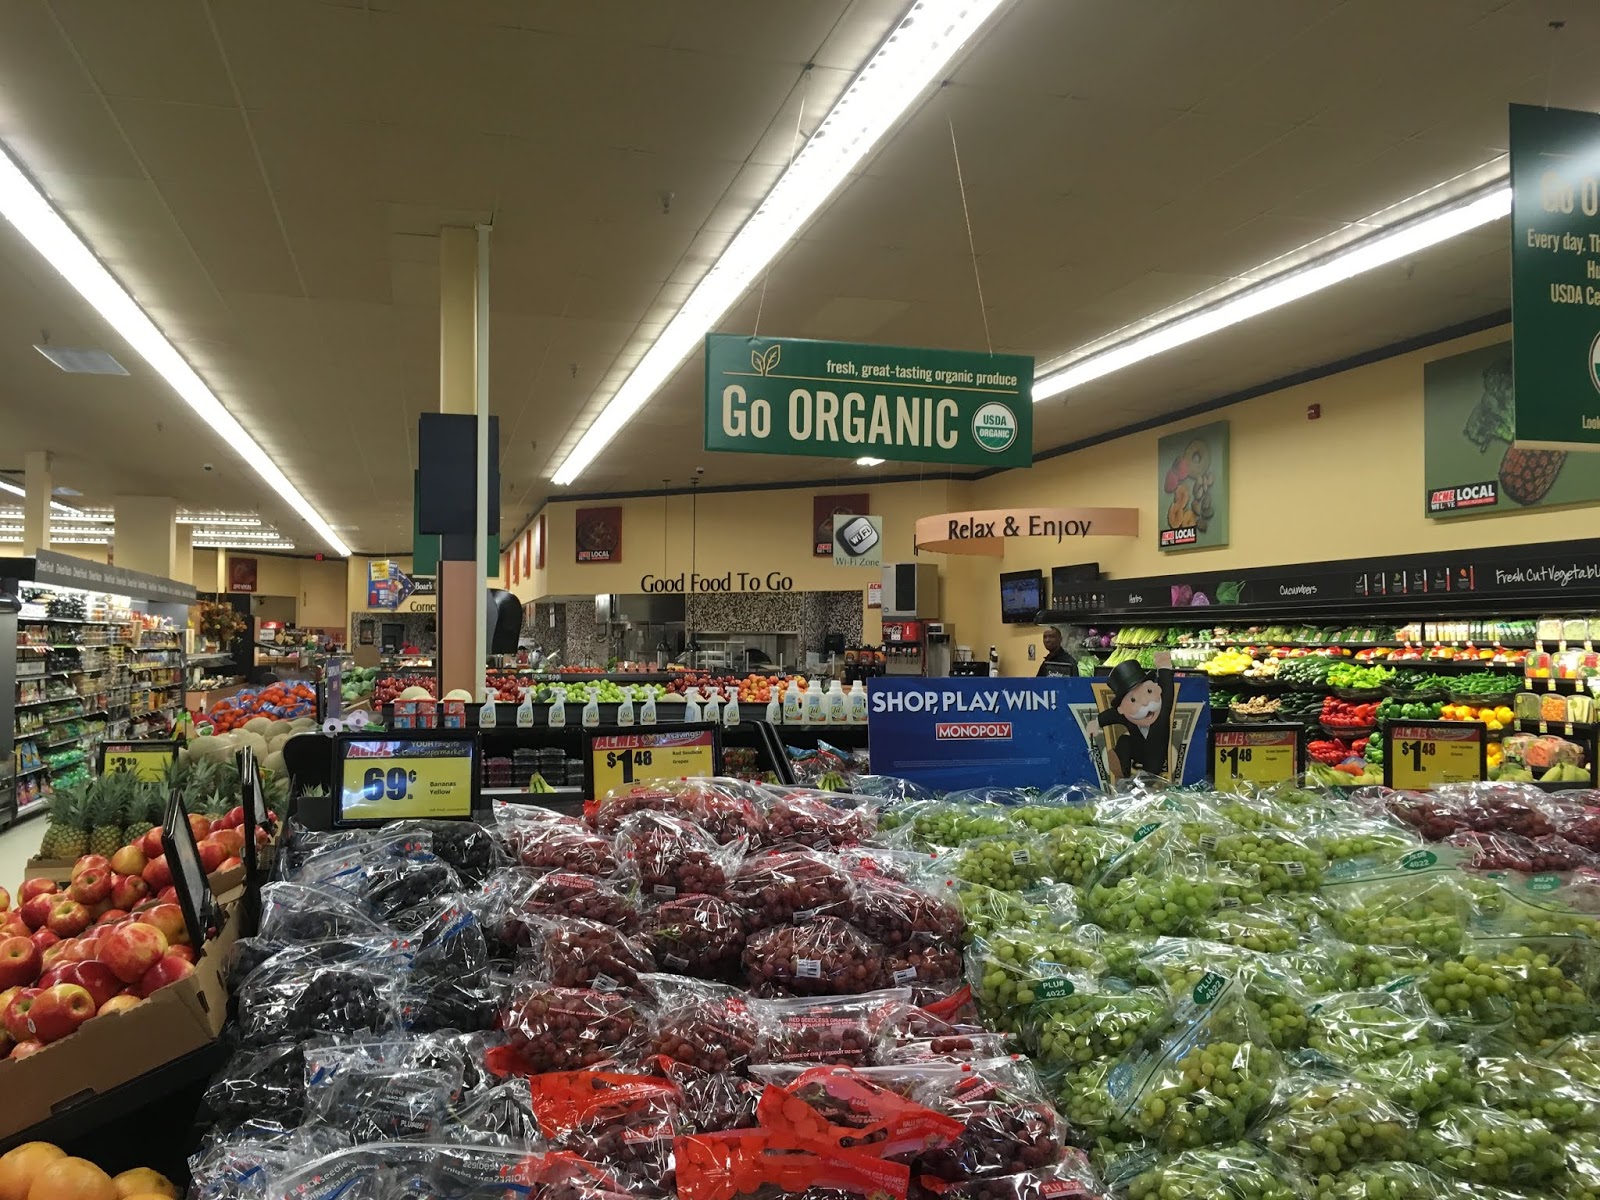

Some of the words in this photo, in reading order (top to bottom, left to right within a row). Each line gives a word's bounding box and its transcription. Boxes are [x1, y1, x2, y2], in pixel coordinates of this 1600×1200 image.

[1528, 228, 1560, 253] Every
[1563, 232, 1586, 254] day.
[1551, 283, 1583, 304] USDA
[827, 360, 858, 376] fresh,
[862, 363, 932, 382] great-tasting
[936, 367, 973, 384] organic
[976, 371, 1017, 387] produce
[722, 385, 771, 438] Go
[788, 388, 958, 449] ORGANIC
[983, 414, 1006, 426] USDA
[980, 428, 1010, 438] ORGANIC
[1432, 490, 1455, 502] ACME
[1456, 485, 1494, 500] LOCAL
[948, 517, 995, 540] Relax
[1003, 516, 1020, 536] &
[1028, 516, 1092, 544] Enjoy
[1175, 528, 1195, 539] LOCAL
[860, 558, 880, 566] Zone
[641, 573, 684, 592] Good
[691, 572, 731, 592] Food
[737, 572, 760, 590] To
[766, 572, 792, 590] Go
[1496, 567, 1524, 584] Fresh
[1526, 566, 1548, 581] Cut
[1280, 585, 1318, 595] Cucumbers
[410, 601, 436, 612] Corne
[872, 691, 938, 714] SHOP,
[942, 690, 1000, 714] PLAY,
[1005, 690, 1056, 710] WIN!
[938, 724, 1010, 738] MONOPOLY
[595, 736, 639, 749] ACME
[422, 749, 466, 758] Supermarket
[1410, 860, 1430, 868] 4022
[1042, 980, 1064, 989] PLU#
[1206, 980, 1222, 1000] 4022
[290, 1175, 320, 1197] BLACK
[1042, 1183, 1062, 1192] PLU
